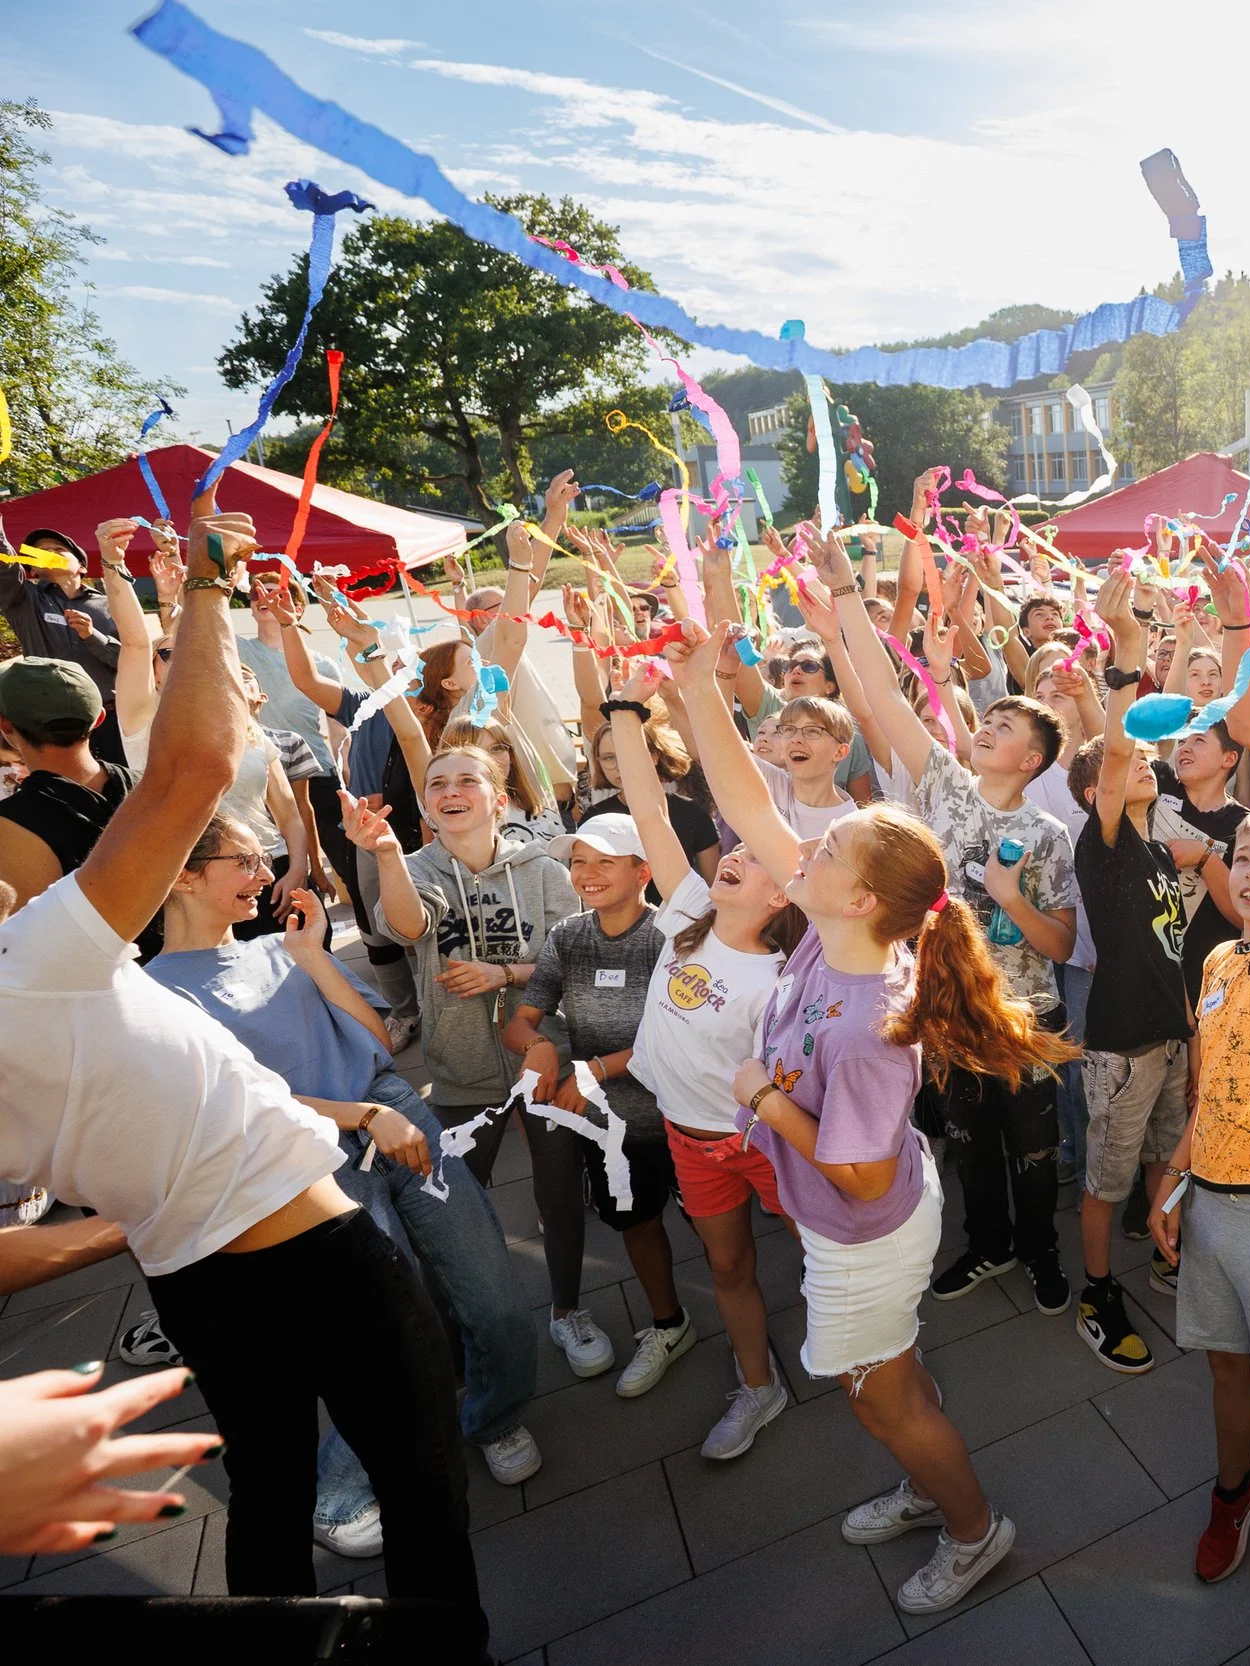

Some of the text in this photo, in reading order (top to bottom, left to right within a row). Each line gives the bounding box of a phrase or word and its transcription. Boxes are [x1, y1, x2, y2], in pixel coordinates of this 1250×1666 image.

[599, 970, 619, 981] Ben
[675, 988, 693, 1004] CAFE
[690, 977, 726, 1013] Rock
[658, 1000, 691, 1025] HAMBURG
